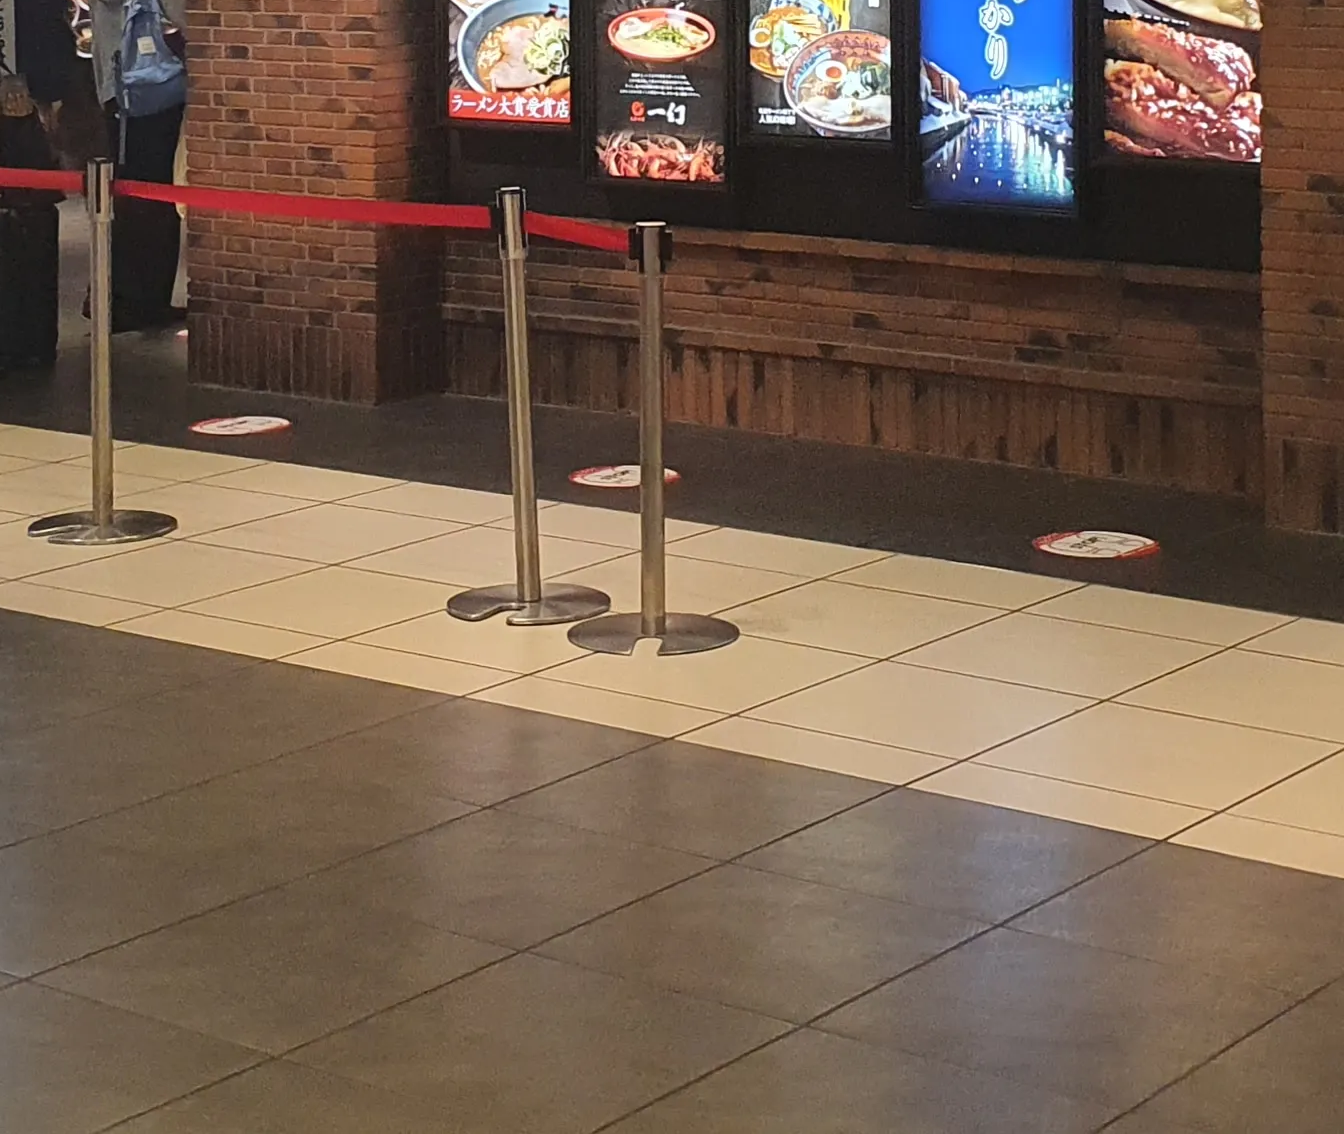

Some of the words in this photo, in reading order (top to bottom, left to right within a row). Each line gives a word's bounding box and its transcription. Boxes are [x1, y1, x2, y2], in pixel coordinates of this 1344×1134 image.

[451, 94, 570, 118] ラーメン大賞受賞店
[647, 102, 686, 125] 一幻
